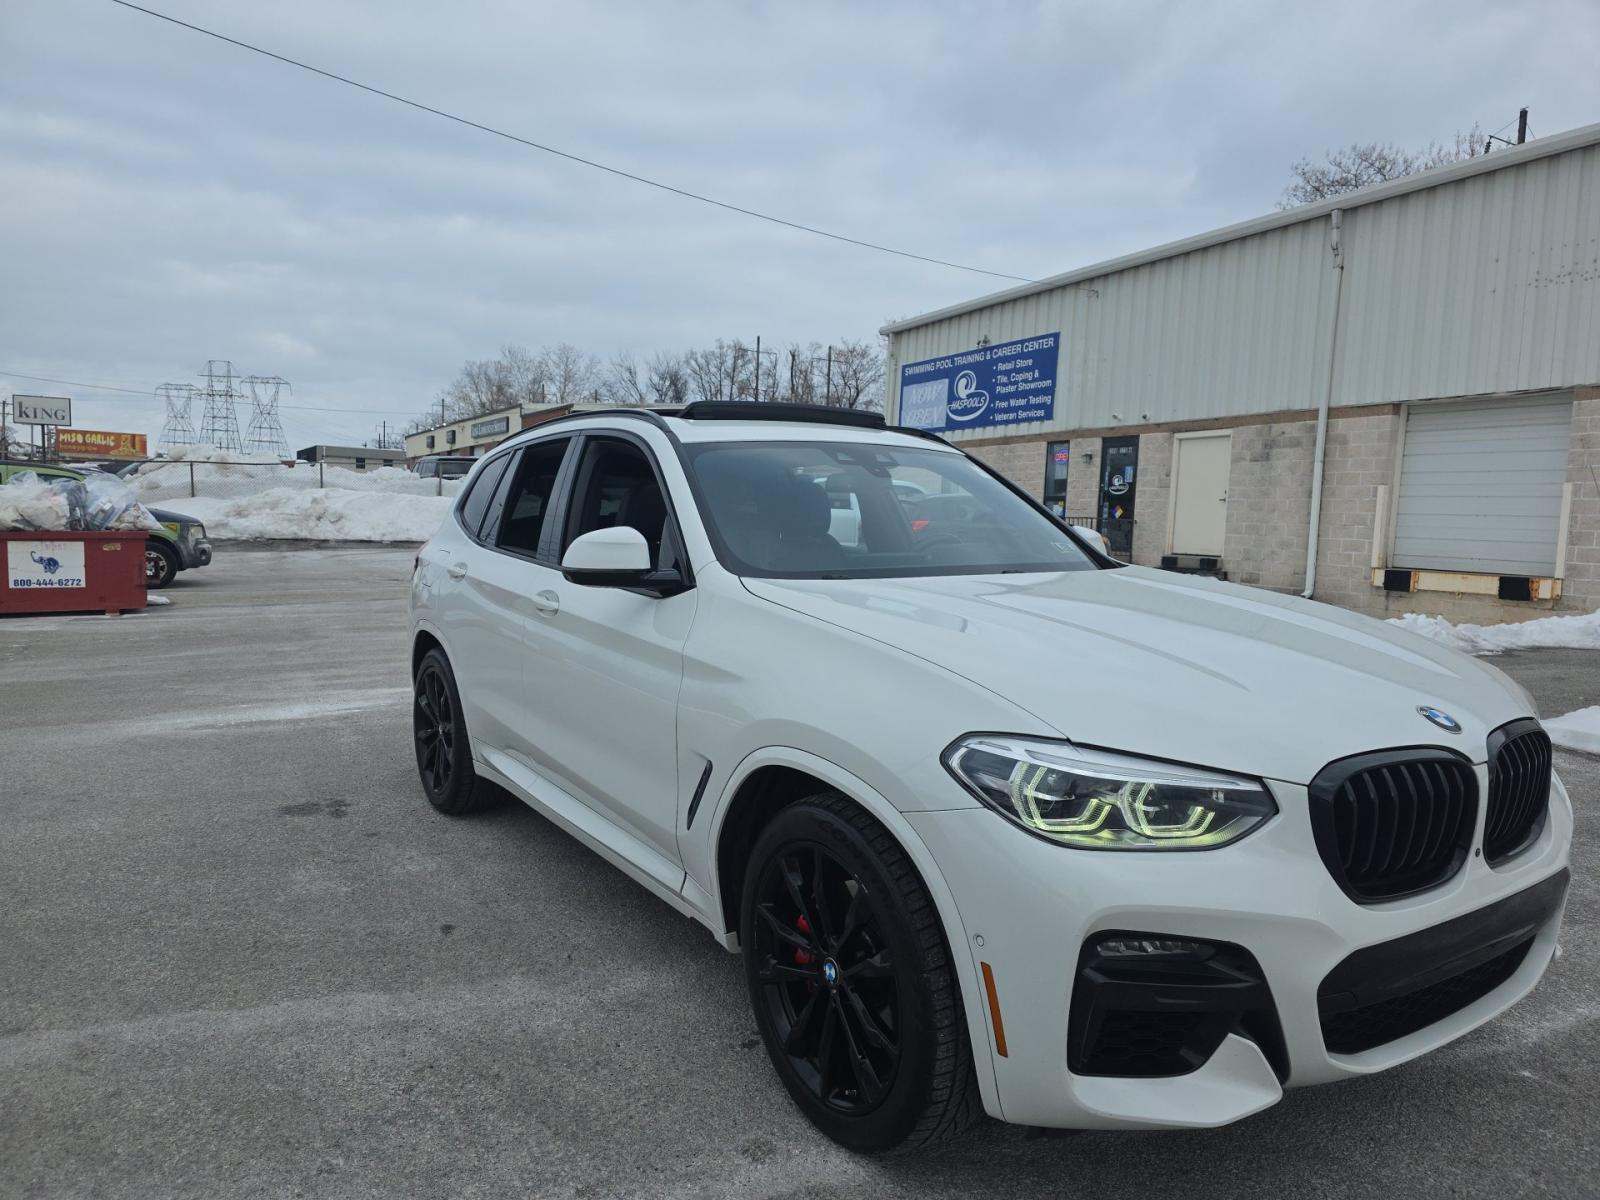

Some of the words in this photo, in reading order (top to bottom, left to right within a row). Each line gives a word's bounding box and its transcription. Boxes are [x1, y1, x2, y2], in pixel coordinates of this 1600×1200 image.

[904, 362, 935, 376] SWIMMING
[936, 359, 953, 370] POOL
[954, 351, 985, 366] TRAINING
[986, 350, 991, 360] &
[992, 344, 1022, 358] CAREER
[1023, 337, 1054, 352] CENTER
[997, 361, 1015, 371] Retail
[1016, 358, 1033, 368] Store
[1010, 371, 1033, 382] Coping
[1033, 369, 1039, 378] &
[996, 384, 1017, 394] Plaster
[1018, 379, 1052, 391] Showroom
[995, 400, 1008, 409] Free
[1010, 398, 1027, 407] Water
[1028, 394, 1052, 405] Testing
[995, 412, 1017, 422] Veteran
[1018, 409, 1045, 419] Services
[60, 432, 83, 444] MISO
[85, 433, 115, 447] GARLIC
[13, 578, 82, 587] 800-444-6272
